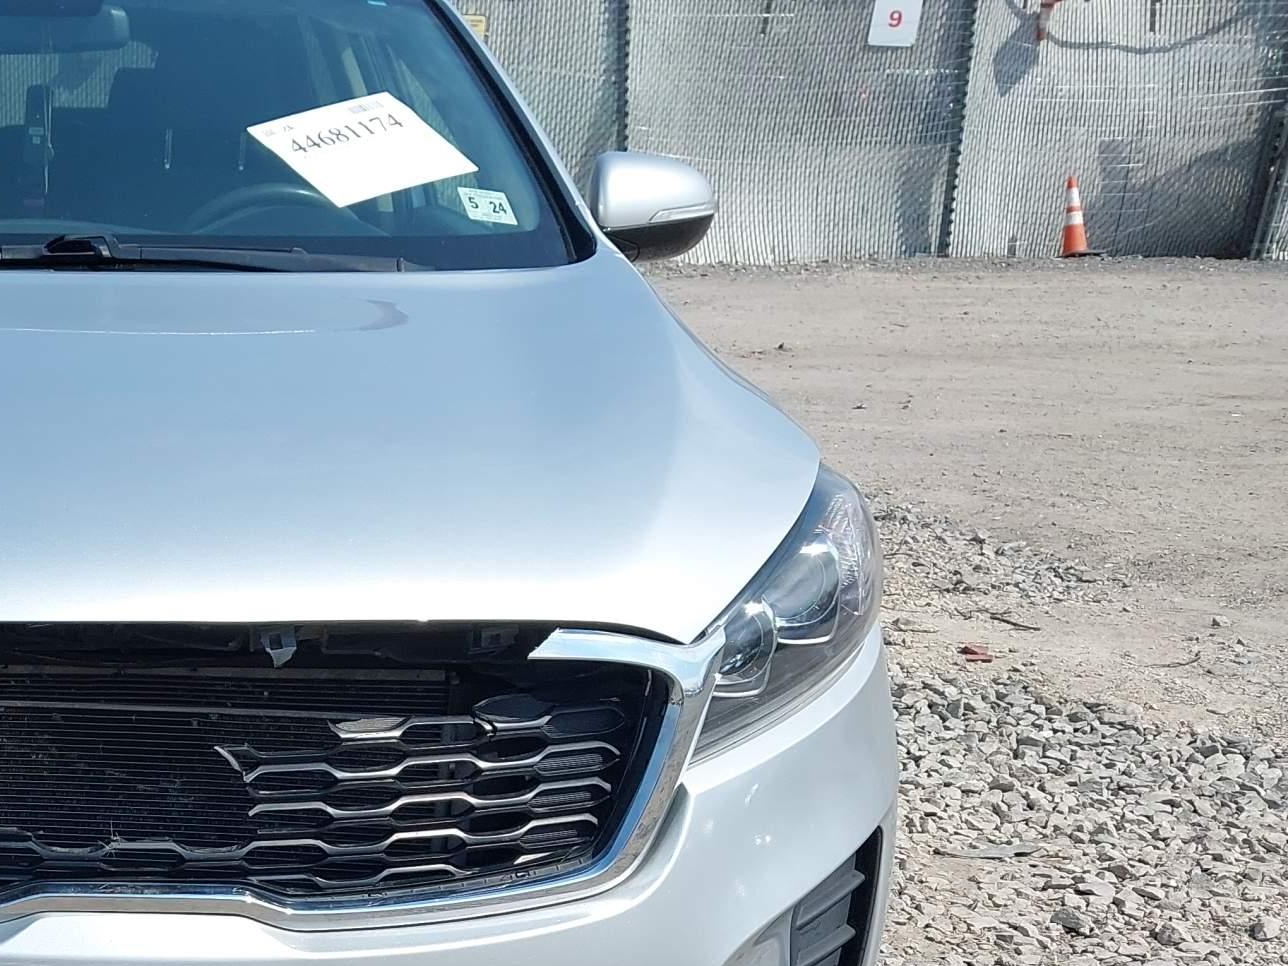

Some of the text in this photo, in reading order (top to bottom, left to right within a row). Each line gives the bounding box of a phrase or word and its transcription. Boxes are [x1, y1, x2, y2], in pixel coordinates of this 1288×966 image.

[888, 10, 902, 27] 9
[291, 113, 403, 152] 44681174
[468, 196, 507, 215] 5 24
